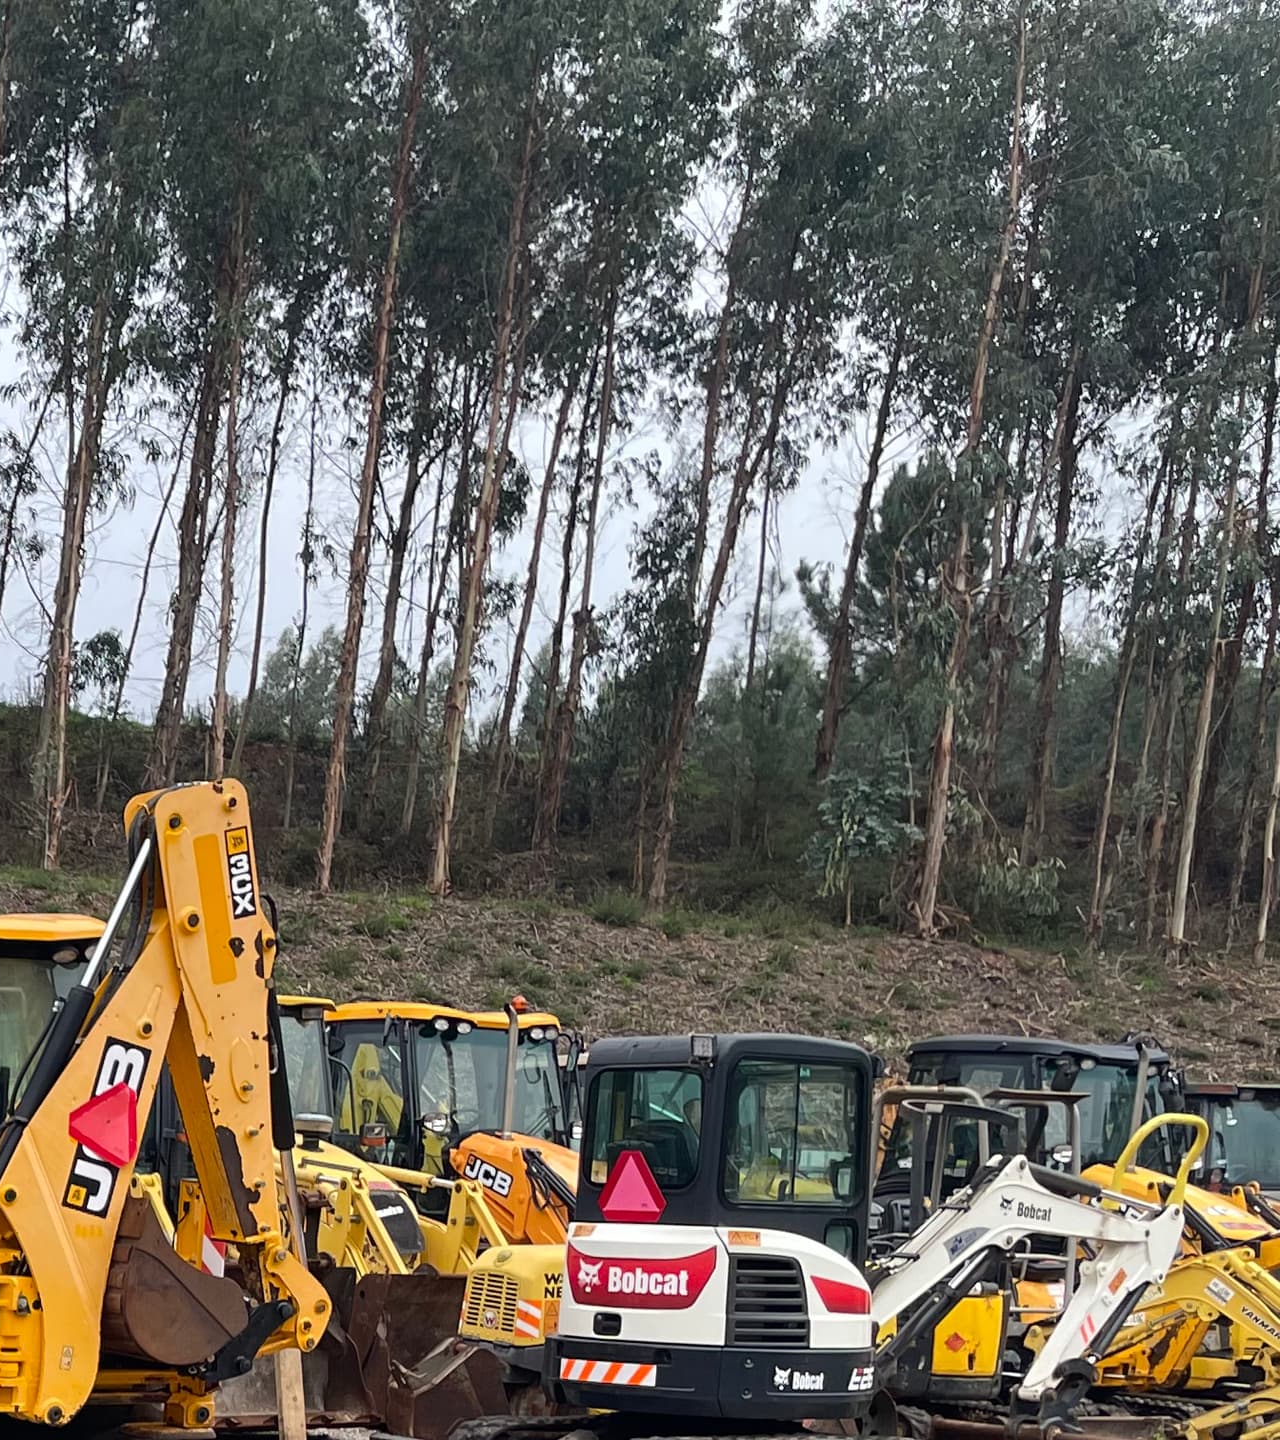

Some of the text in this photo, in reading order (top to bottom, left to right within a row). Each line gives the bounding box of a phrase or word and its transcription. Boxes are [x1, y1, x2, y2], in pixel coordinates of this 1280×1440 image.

[230, 854, 256, 915] 3CX
[74, 1044, 144, 1212] JB
[465, 1159, 512, 1196] JCB
[1017, 1202, 1052, 1222] Bobcat
[608, 1266, 689, 1296] Bobcat
[792, 1371, 824, 1390] Bobcat
